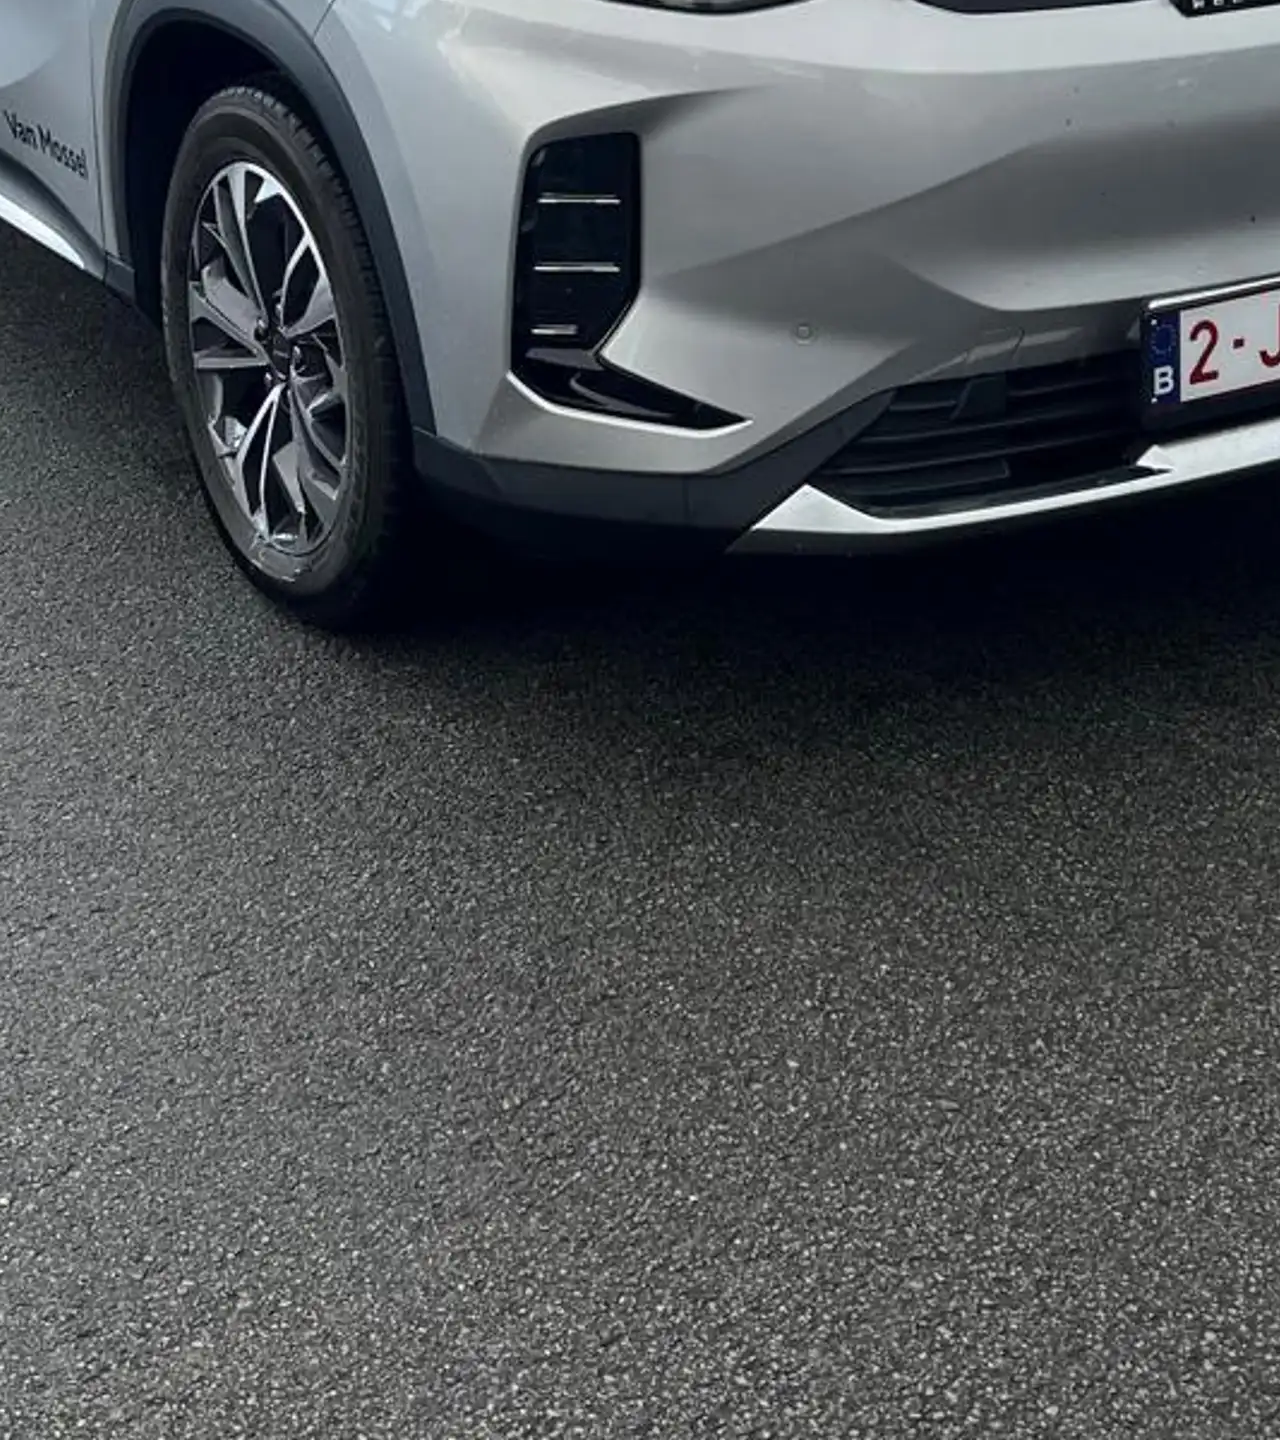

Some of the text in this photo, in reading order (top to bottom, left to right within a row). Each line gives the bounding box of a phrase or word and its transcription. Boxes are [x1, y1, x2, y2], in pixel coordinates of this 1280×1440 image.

[3, 110, 89, 181] Van Mossel
[1153, 366, 1175, 395] B
